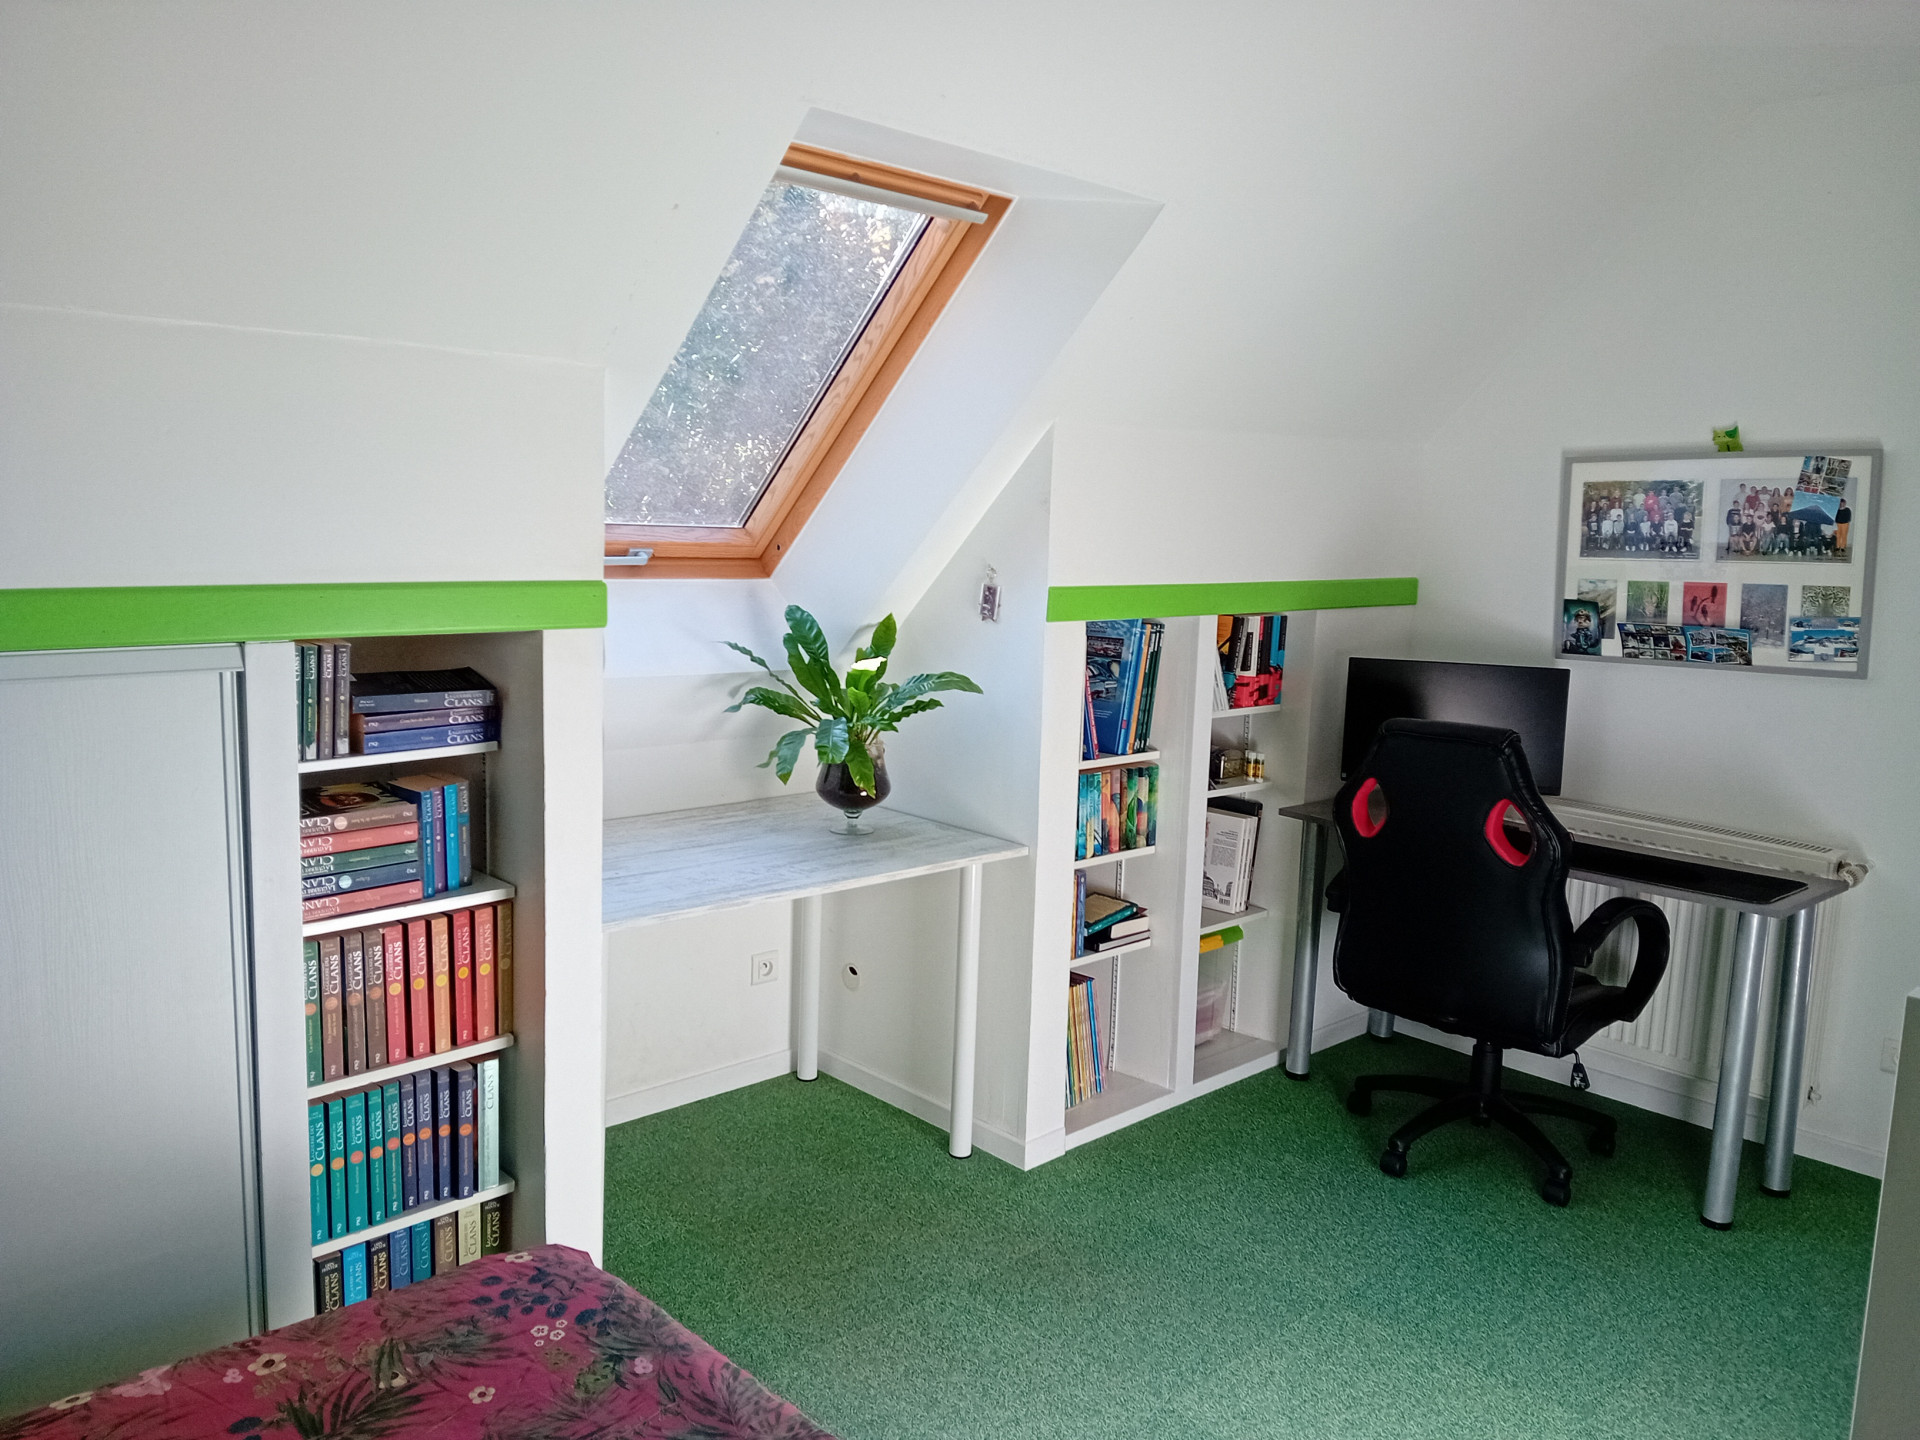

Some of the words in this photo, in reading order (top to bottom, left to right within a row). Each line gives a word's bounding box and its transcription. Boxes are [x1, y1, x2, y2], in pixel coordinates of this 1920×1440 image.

[444, 699, 483, 707] CLANS
[449, 715, 484, 724] CLANS
[447, 733, 484, 743] CLANS
[299, 817, 331, 827] CLAN
[300, 836, 332, 848] CLAN
[300, 855, 334, 867] CLAN
[301, 876, 336, 888] CLAN
[417, 937, 426, 974] CLANS
[440, 934, 448, 971] CLANS
[484, 924, 492, 960] CLANS
[330, 954, 339, 994] CLANS
[353, 951, 362, 990] CLANS
[374, 946, 382, 984] CLANS
[394, 942, 402, 979] CLANS
[308, 960, 318, 999] CLANS
[316, 1122, 324, 1160] CLANS
[445, 1226, 453, 1262] CLANS
[469, 1220, 477, 1255] CLANS
[491, 1212, 500, 1246] CLANS
[400, 1239, 408, 1276] CLANS
[421, 1233, 429, 1268] CLANS
[378, 1252, 387, 1289] CLANS
[330, 1272, 339, 1310] CLANS
